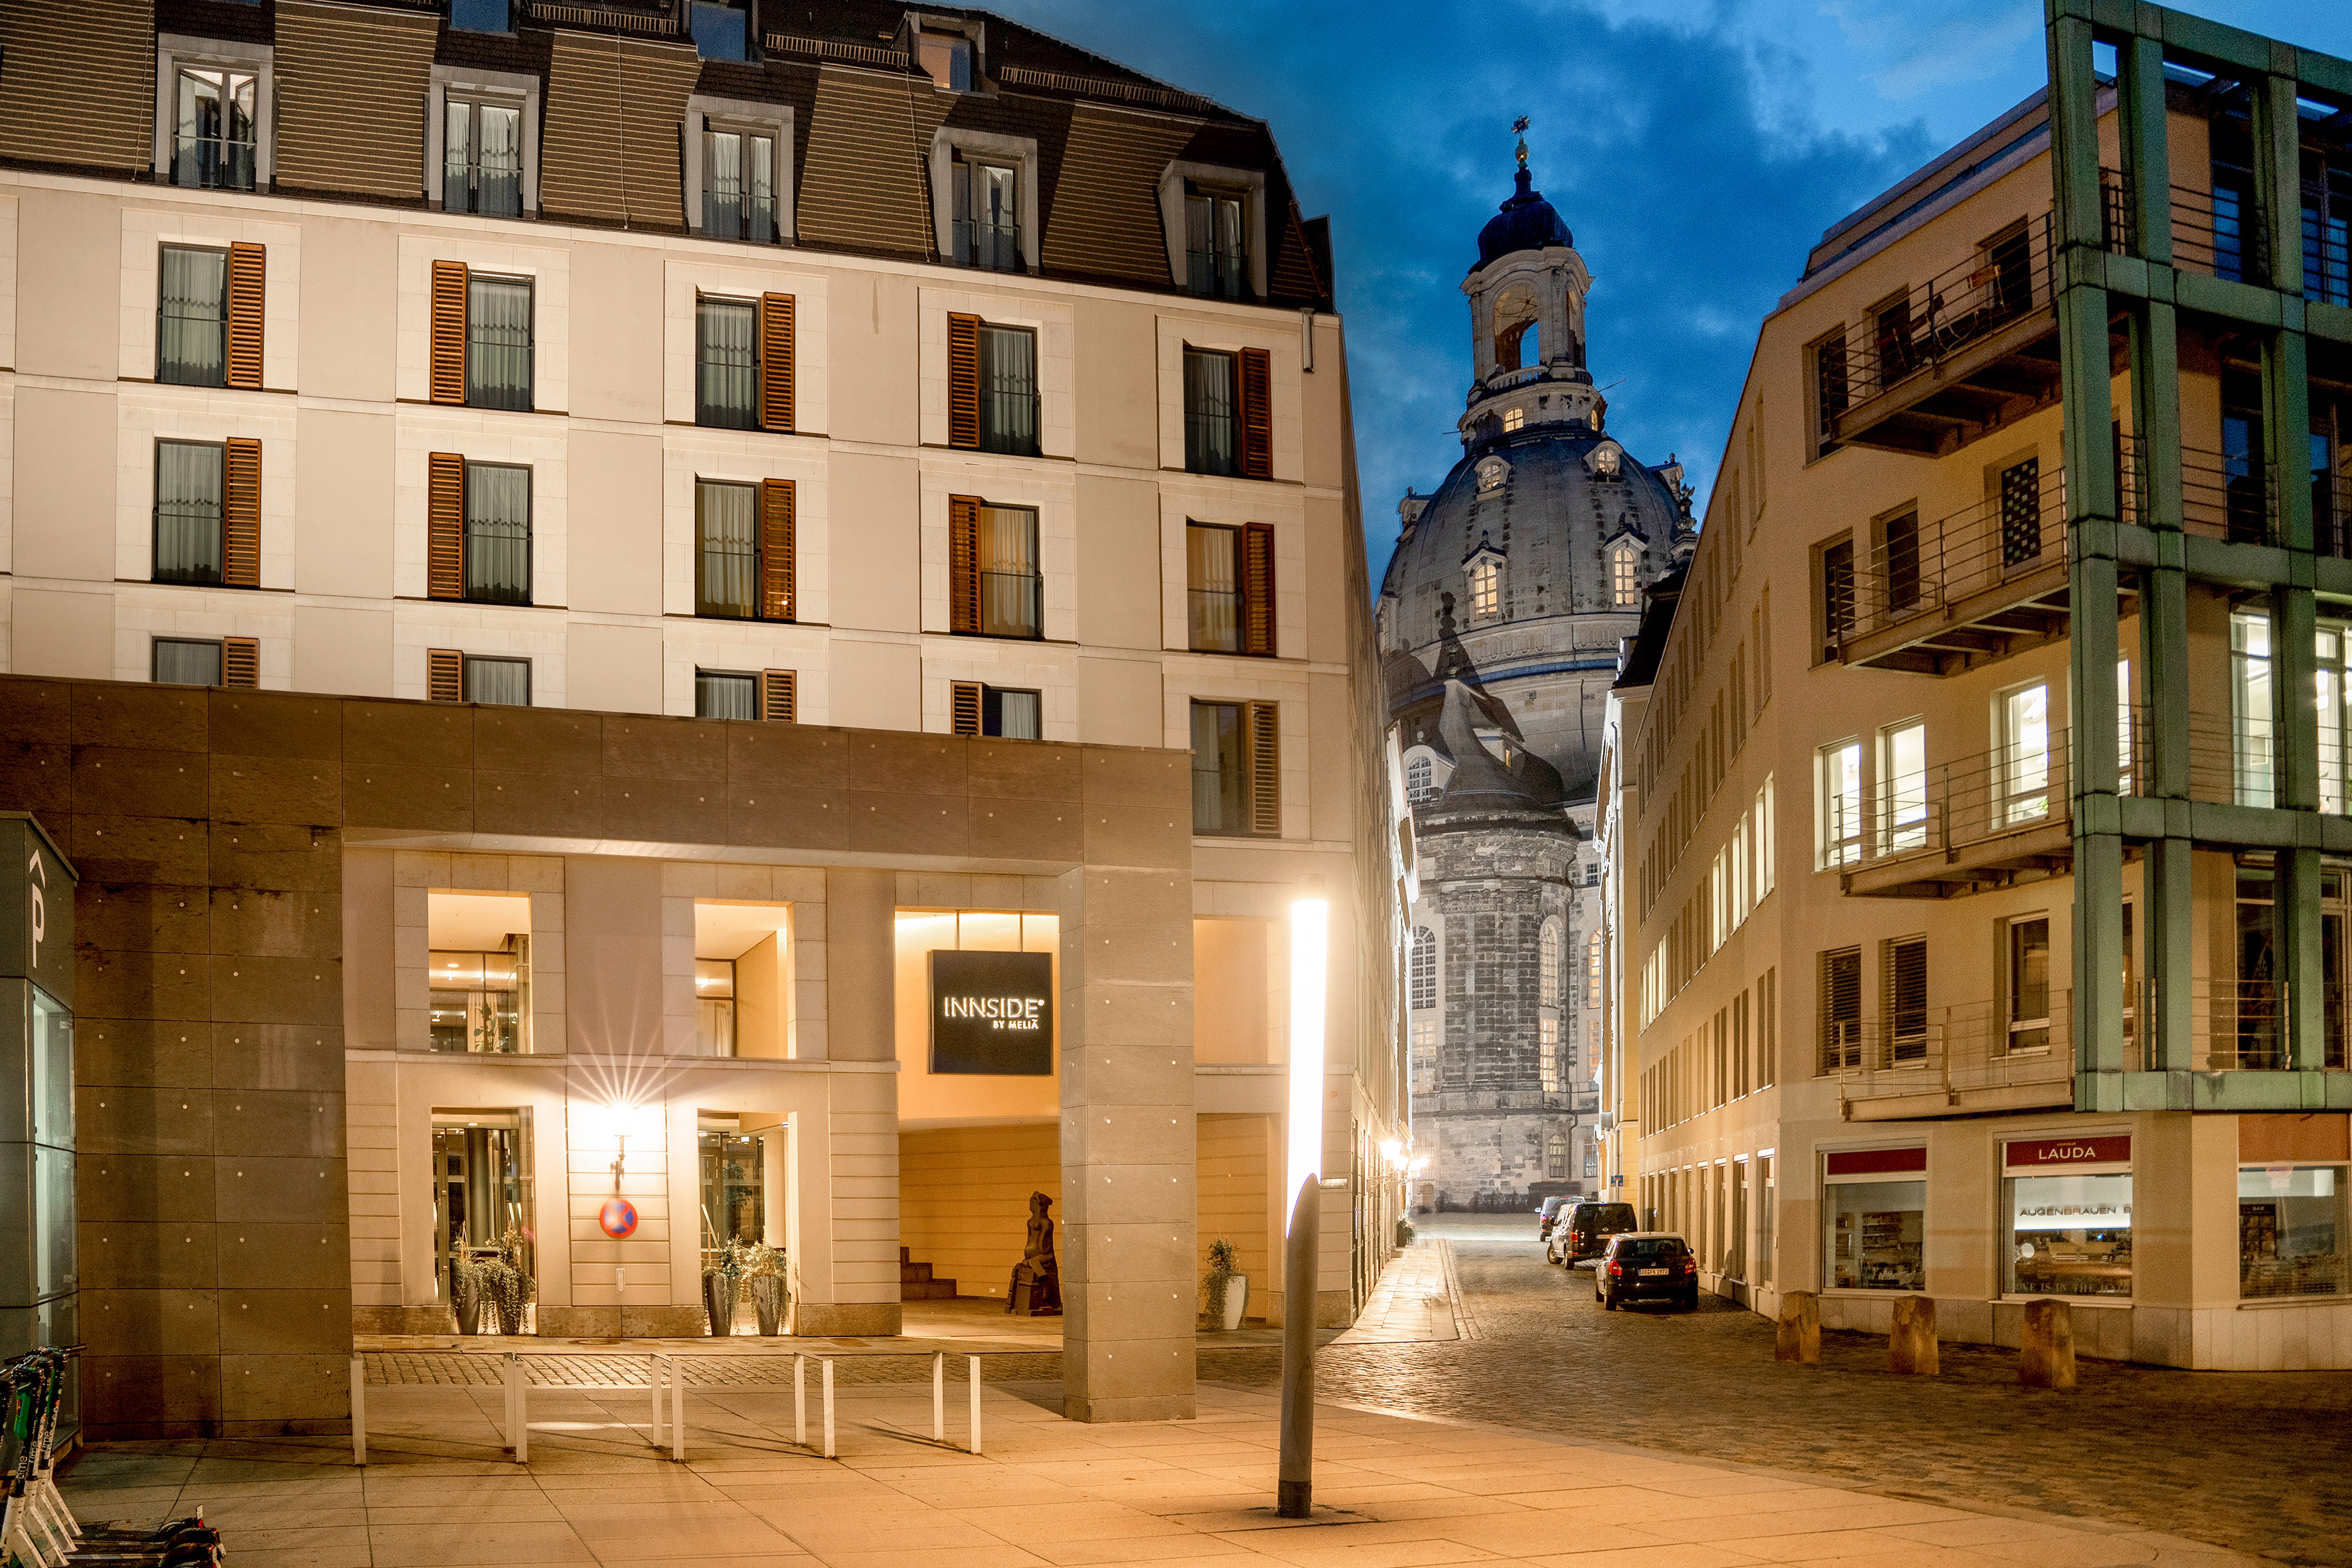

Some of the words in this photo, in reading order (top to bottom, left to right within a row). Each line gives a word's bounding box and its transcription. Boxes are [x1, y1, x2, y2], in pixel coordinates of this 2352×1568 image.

[33, 882, 44, 969] P
[945, 997, 1039, 1018] INNSIDE
[992, 1020, 1005, 1029] BY
[2039, 1146, 2096, 1160] LAUDA
[2019, 1207, 2116, 1216] AUGENBRAUEN
[2041, 1283, 2051, 1291] IS
[2071, 1283, 2096, 1293] THE
